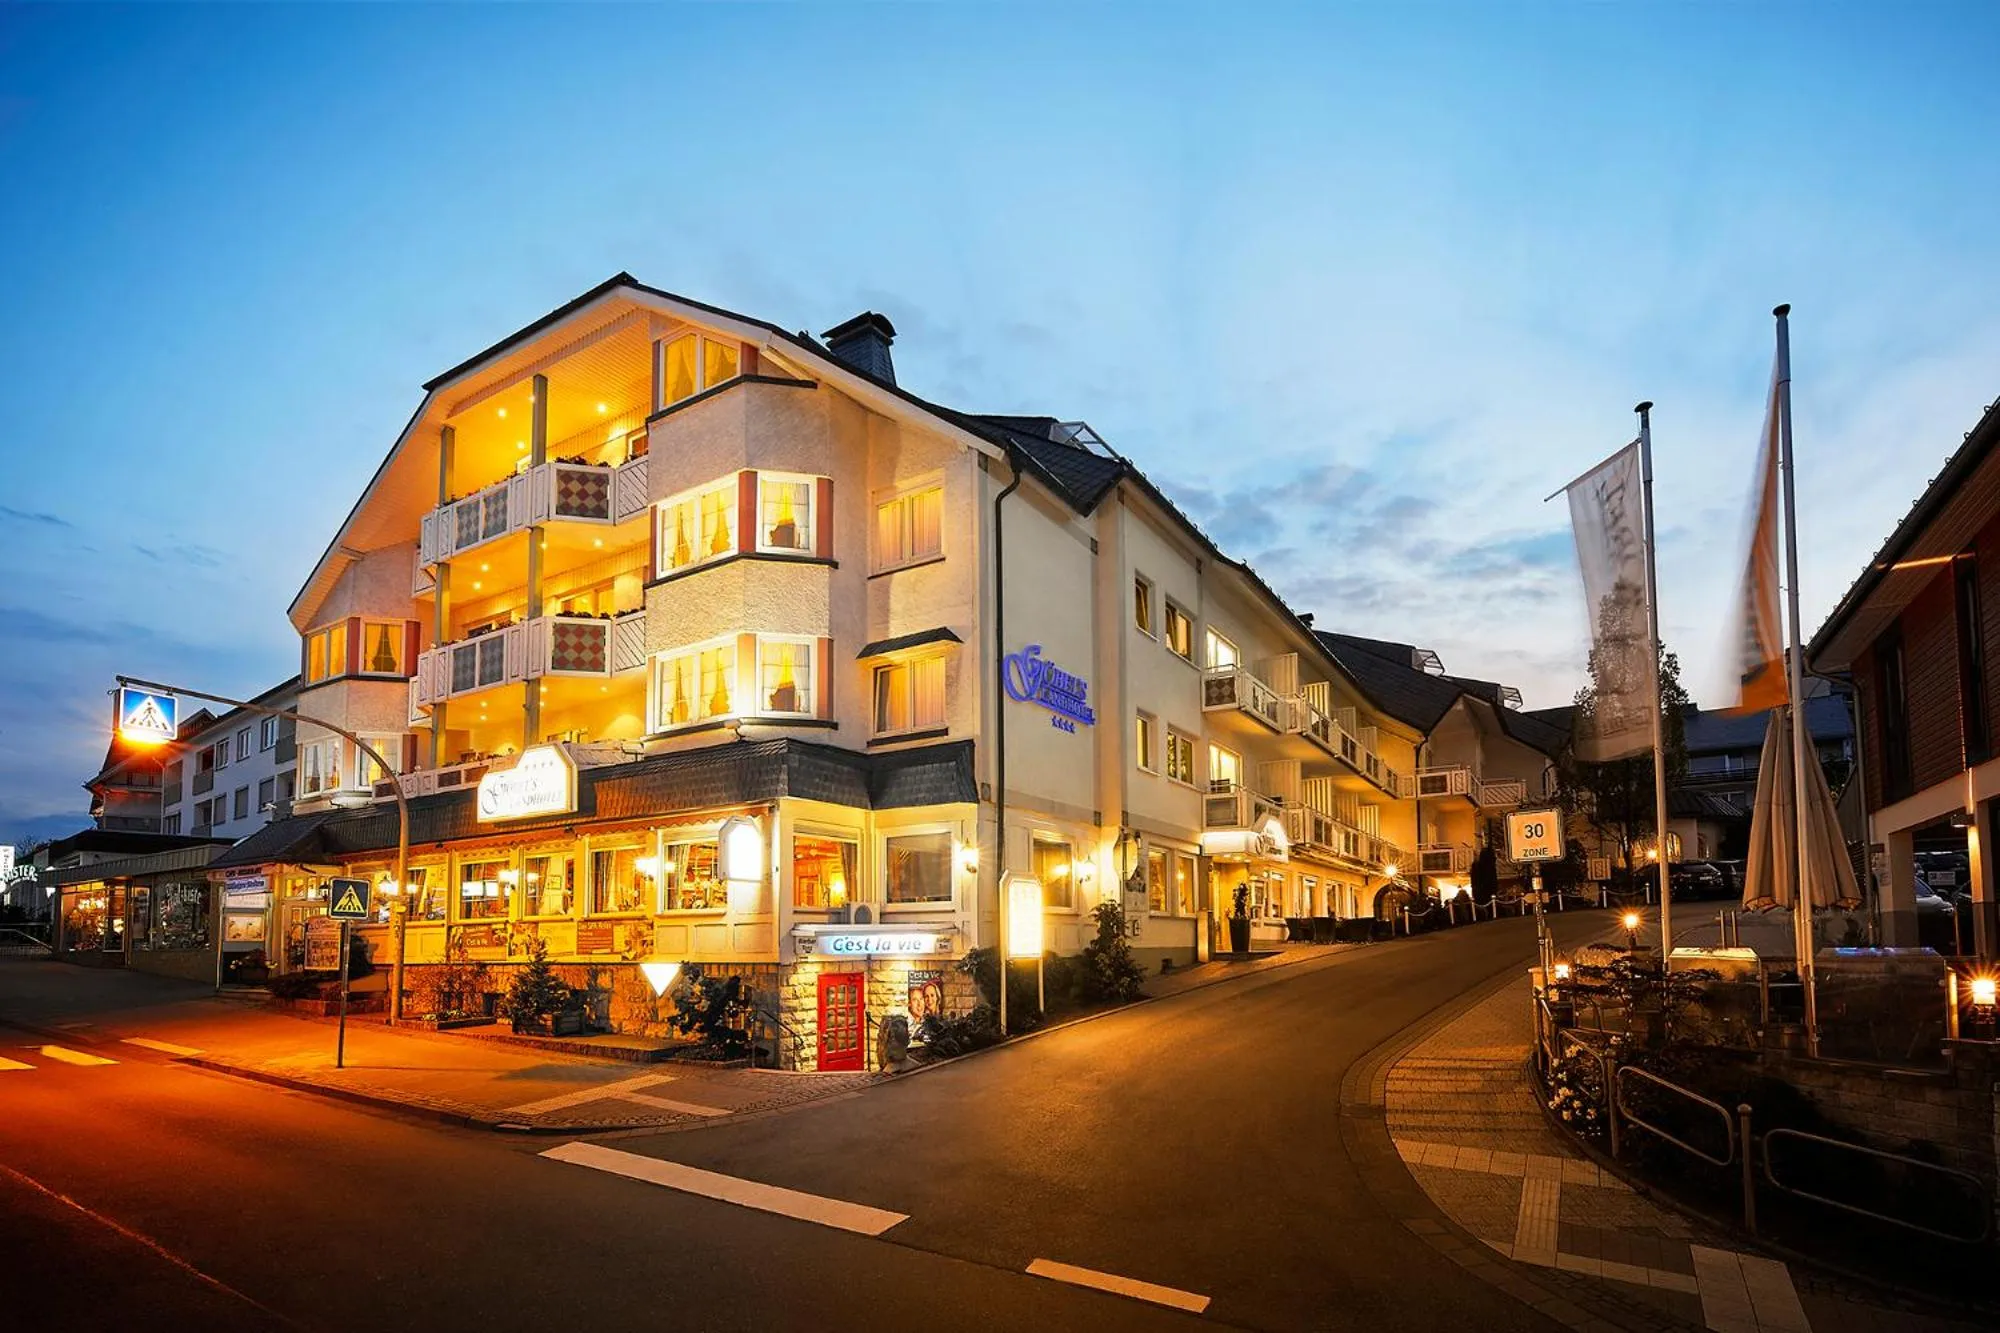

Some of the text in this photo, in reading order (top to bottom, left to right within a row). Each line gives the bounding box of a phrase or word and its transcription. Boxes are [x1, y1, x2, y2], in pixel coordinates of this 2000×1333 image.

[1524, 823, 1544, 838] 30
[1523, 847, 1549, 857] ZONE
[875, 938, 891, 951] la
[898, 938, 922, 951] vie
